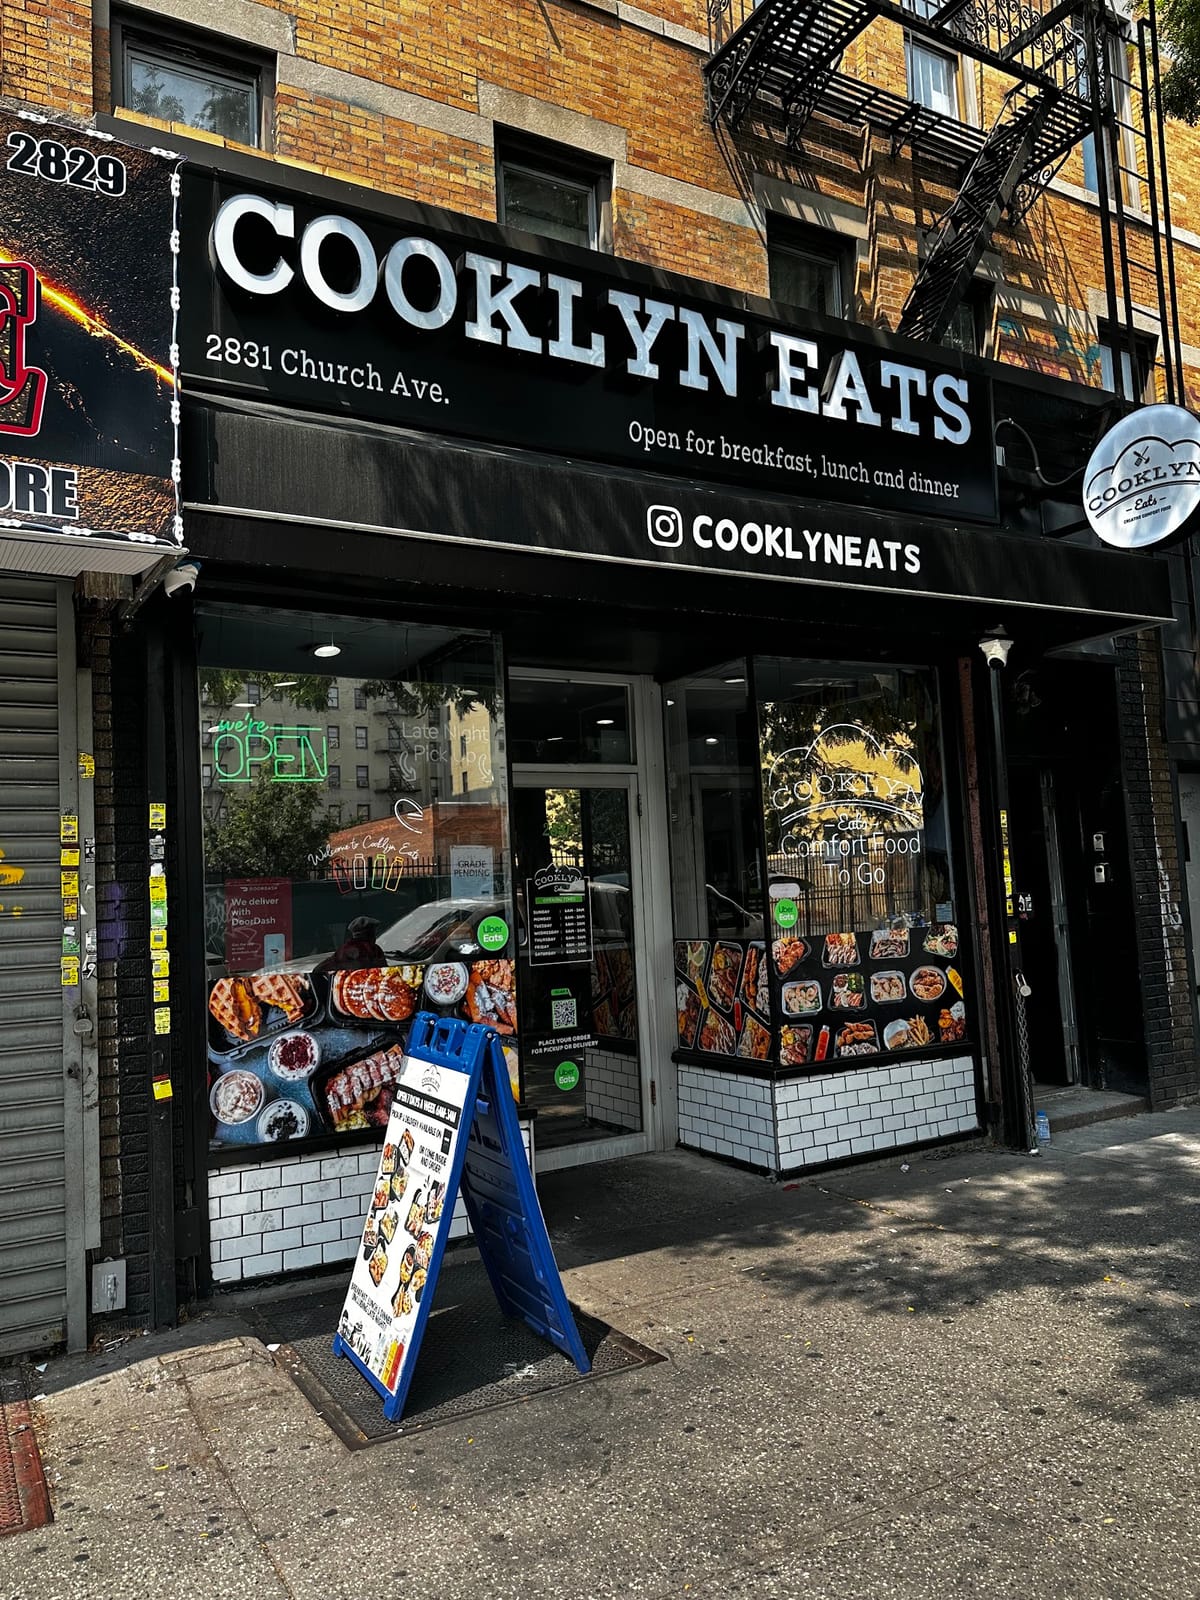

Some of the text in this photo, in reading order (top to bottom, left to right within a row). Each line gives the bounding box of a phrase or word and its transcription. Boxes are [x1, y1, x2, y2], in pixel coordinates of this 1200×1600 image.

[7, 131, 127, 197] 2829
[211, 193, 747, 398] COOKLYN
[768, 330, 972, 446] EATS
[205, 334, 451, 405] 2831 Church Ave.
[629, 420, 961, 501] Open for breakfast, lunch and dinner
[1134, 494, 1158, 511] Eats
[692, 514, 922, 574] COOKLYNEATS
[218, 711, 270, 735] we're
[402, 721, 440, 740] Late
[214, 733, 328, 778] OPEN
[414, 744, 448, 763] Pick
[772, 772, 925, 810] COOKLYN
[837, 813, 868, 831] Eats
[781, 831, 921, 857] Comfort Food
[308, 843, 351, 866] Welcome
[454, 869, 490, 878] PENDING
[458, 860, 488, 869] GRADE
[822, 861, 885, 886] To Go
[534, 873, 582, 887] COOKLYN
[231, 896, 280, 906] We deliver
[779, 905, 794, 913] Uber
[231, 907, 251, 917] with
[231, 916, 276, 927] DoorDash
[483, 924, 503, 934] Uber
[483, 933, 504, 943] Eats
[531, 1039, 599, 1056] FOR PICKUP OR DELIVERY
[538, 1033, 591, 1047] PLACE YOUR ORDER
[558, 1068, 575, 1076] Uber
